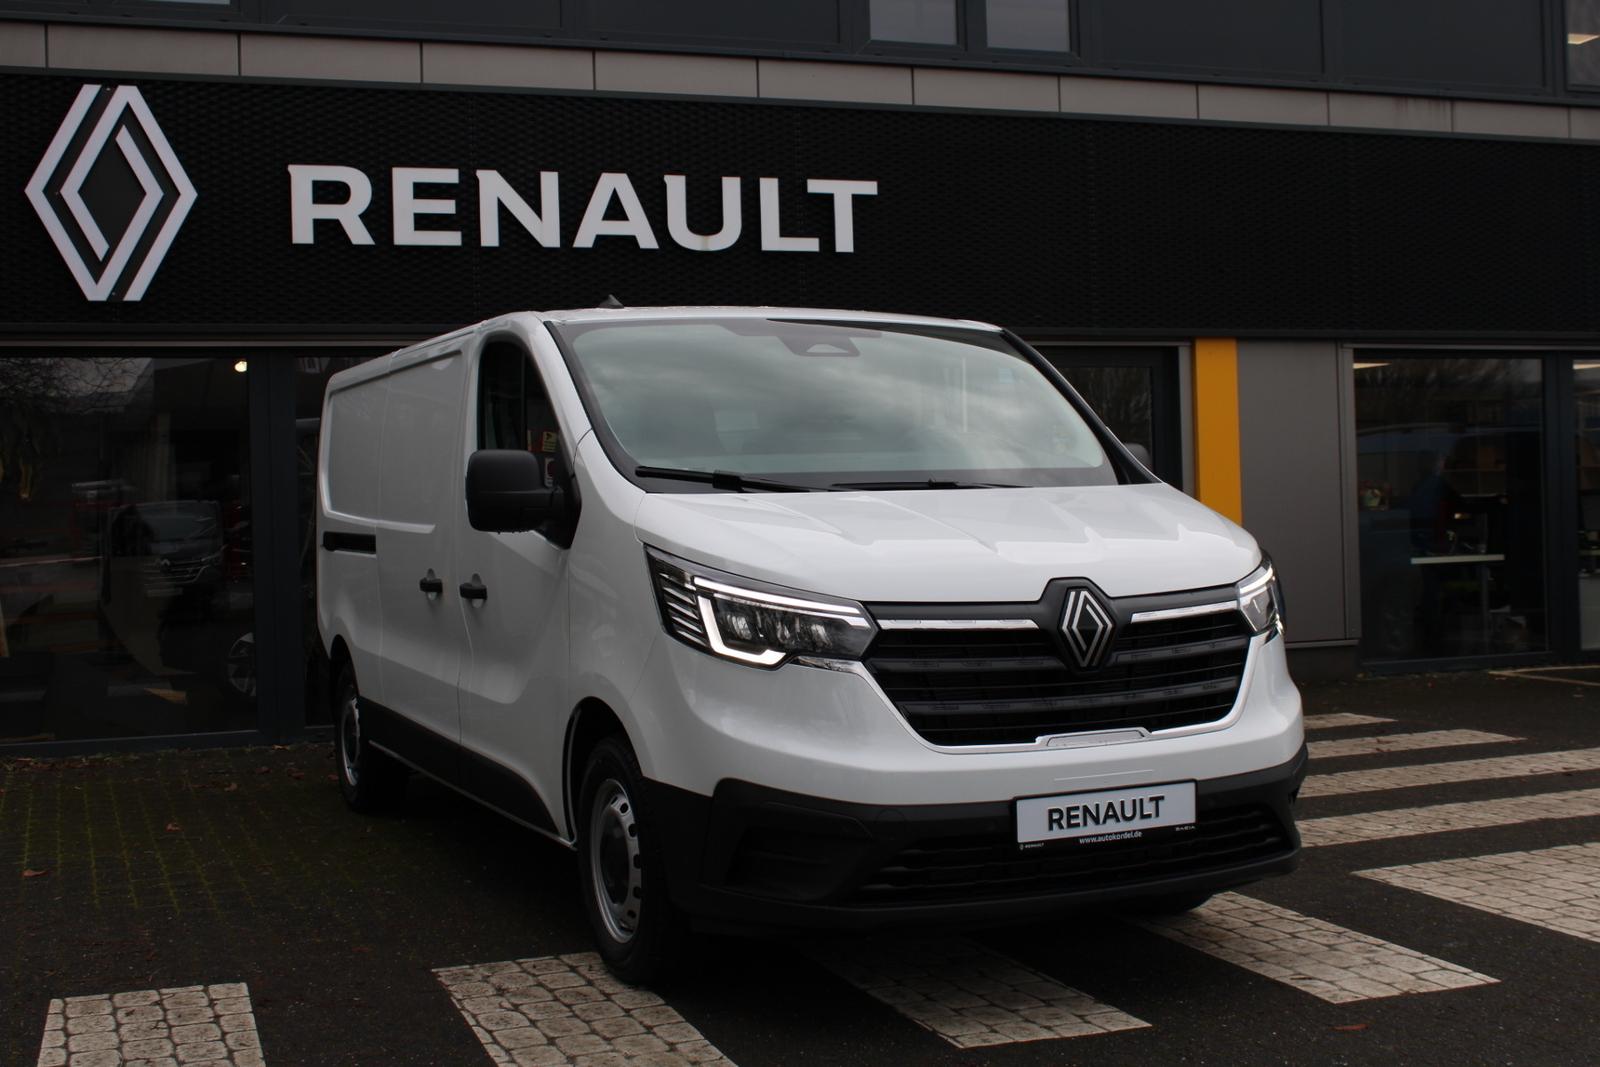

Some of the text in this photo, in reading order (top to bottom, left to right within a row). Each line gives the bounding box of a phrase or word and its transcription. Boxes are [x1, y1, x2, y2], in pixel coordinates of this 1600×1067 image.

[288, 164, 878, 253] RENAULT
[1047, 795, 1165, 832] RENAULT
[1079, 831, 1143, 844] www.autokordel.de
